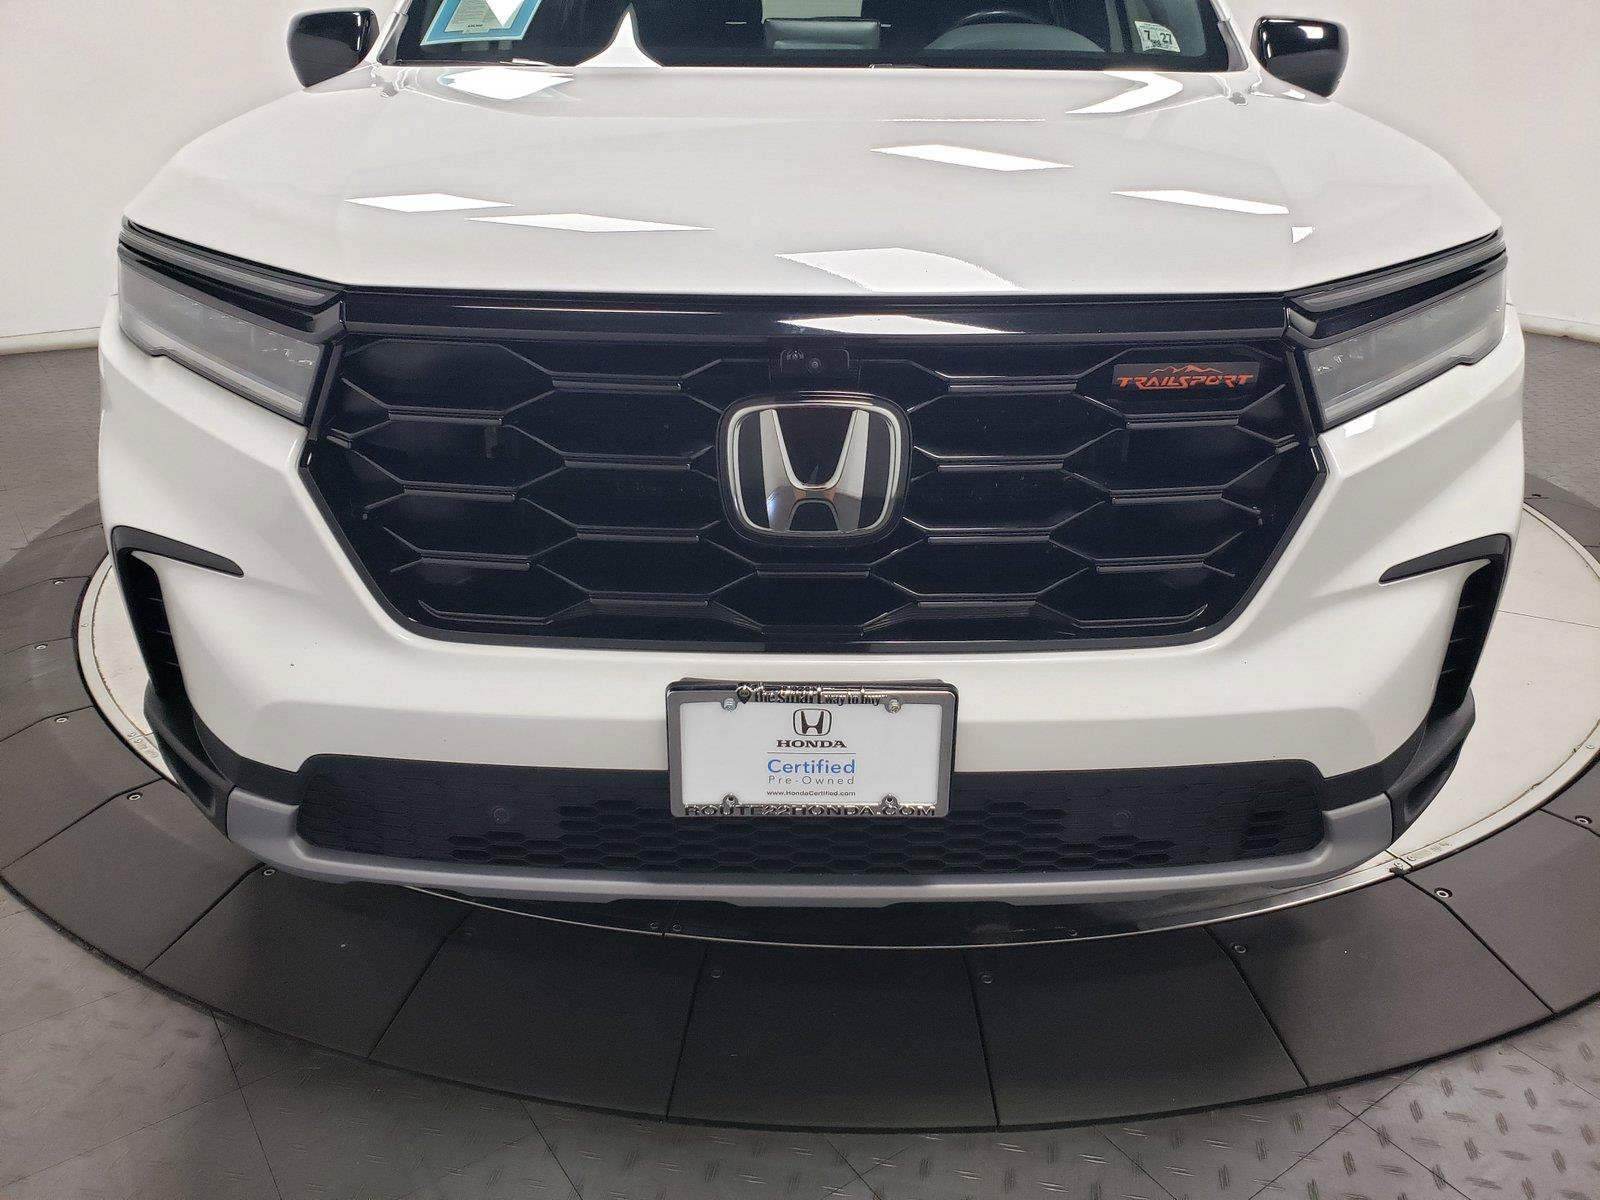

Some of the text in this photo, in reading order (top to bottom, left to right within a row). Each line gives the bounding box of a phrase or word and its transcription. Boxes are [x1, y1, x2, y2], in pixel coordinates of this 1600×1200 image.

[1144, 30, 1151, 41] 7
[1160, 33, 1173, 45] 27
[1117, 375, 1253, 390] TRAILSPORT
[776, 739, 847, 748] HONDA
[767, 759, 855, 774] Certified
[768, 775, 855, 785] Pre-Owned
[684, 804, 936, 816] ROUTE22HONDA.COM
